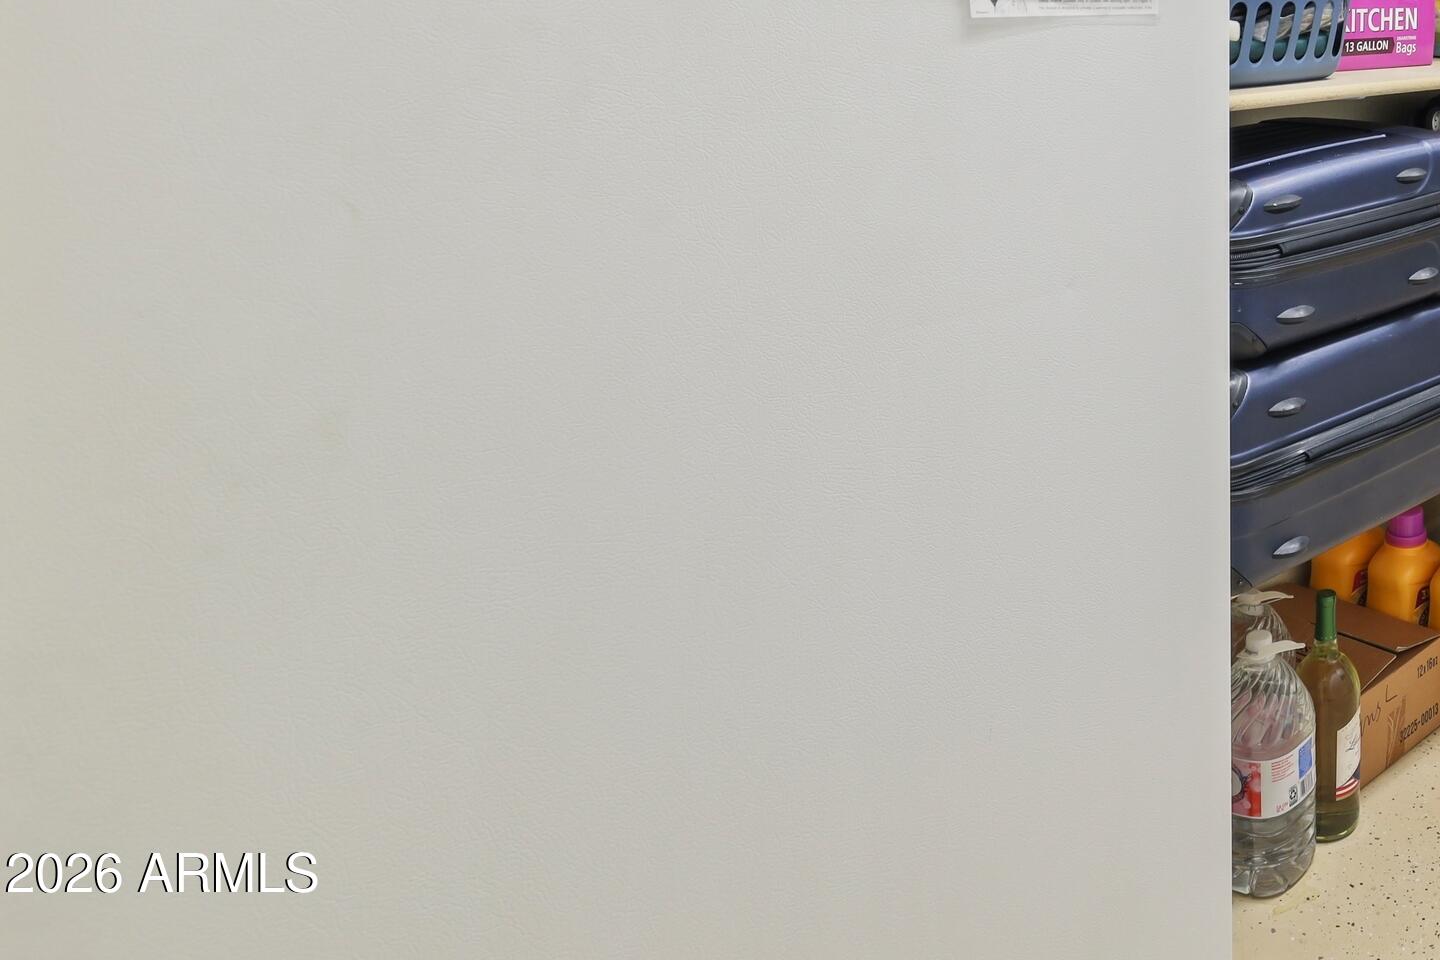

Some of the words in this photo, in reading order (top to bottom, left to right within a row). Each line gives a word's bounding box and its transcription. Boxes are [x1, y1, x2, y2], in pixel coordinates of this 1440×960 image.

[1345, 41, 1355, 53] 13
[1356, 39, 1389, 52] GALLON
[1396, 41, 1417, 56] Bags
